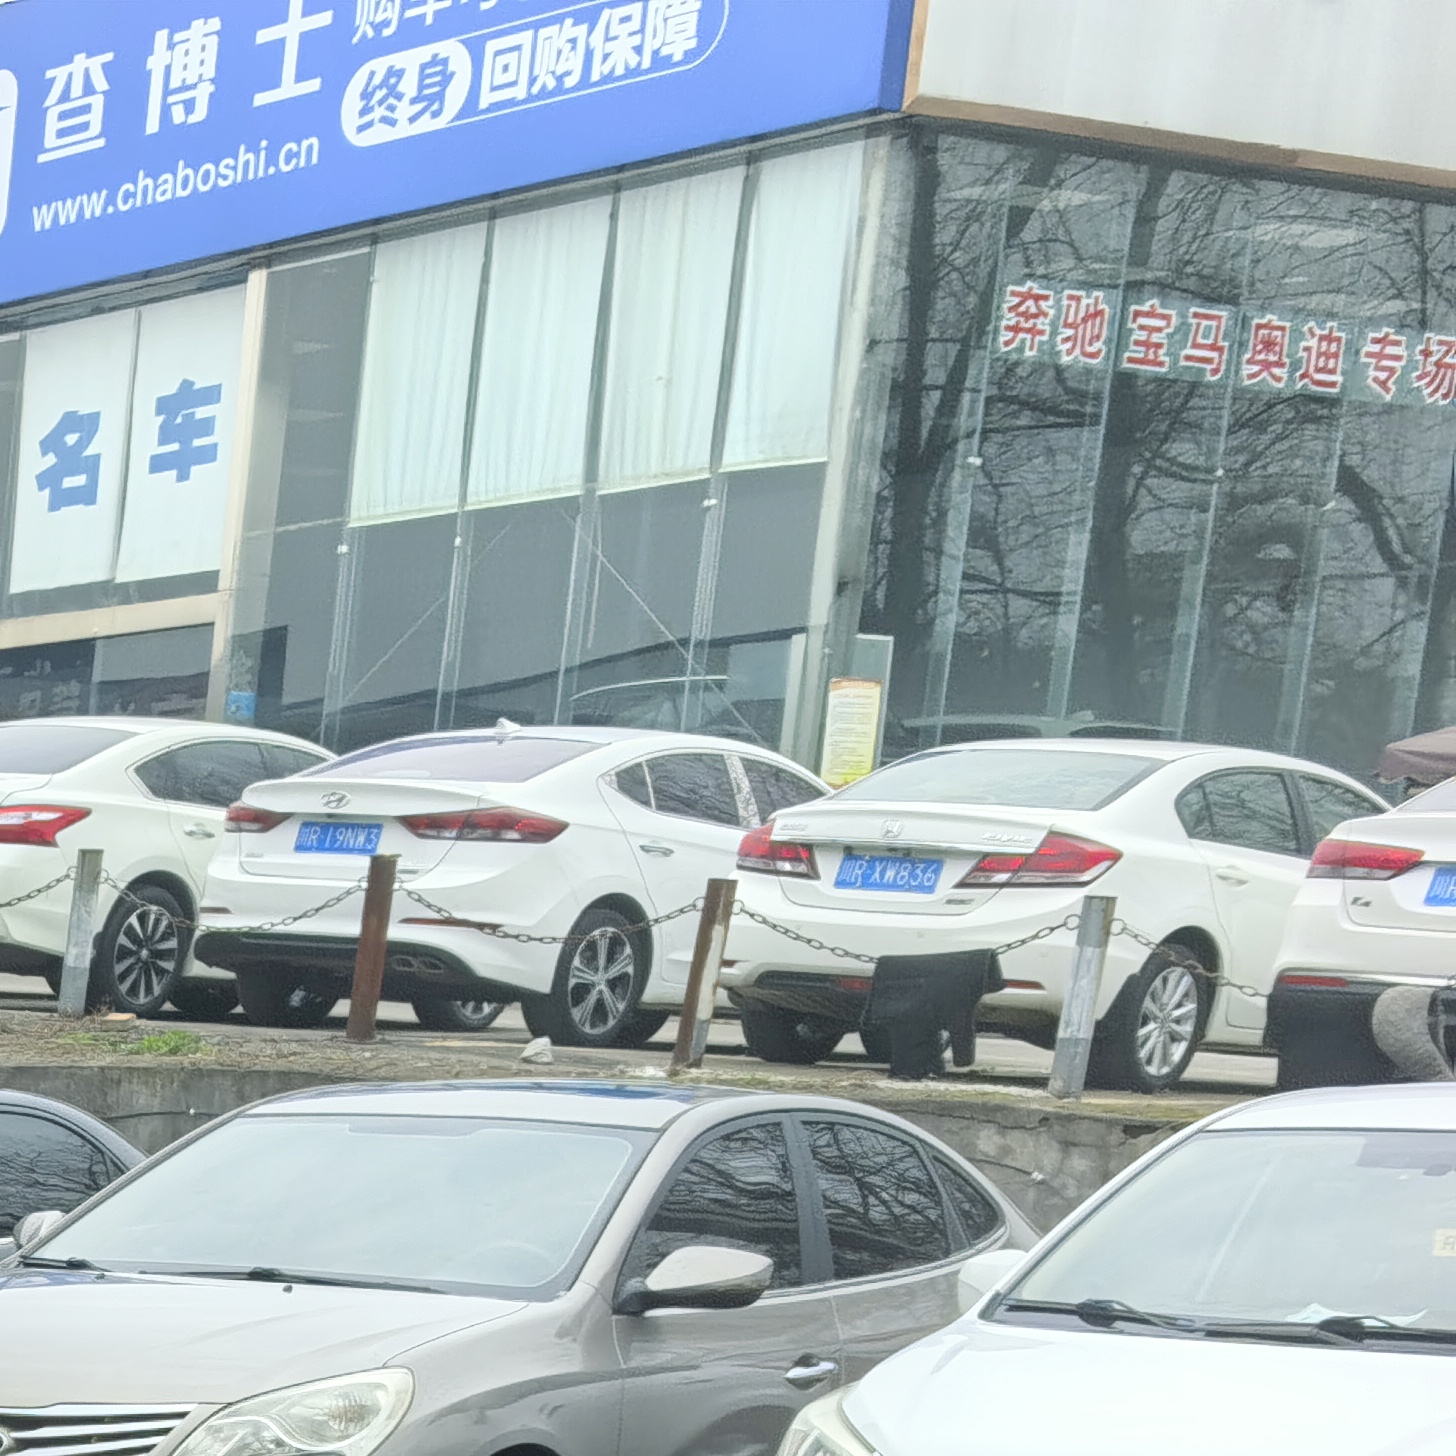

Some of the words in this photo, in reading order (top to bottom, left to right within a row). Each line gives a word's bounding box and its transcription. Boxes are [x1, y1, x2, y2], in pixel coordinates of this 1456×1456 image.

[37, 0, 334, 164] 查博士
[355, 51, 460, 134] 终身
[479, 0, 700, 110] 回购保障
[30, 133, 320, 232] www.chaboshi.cn
[35, 377, 223, 513] 名车
